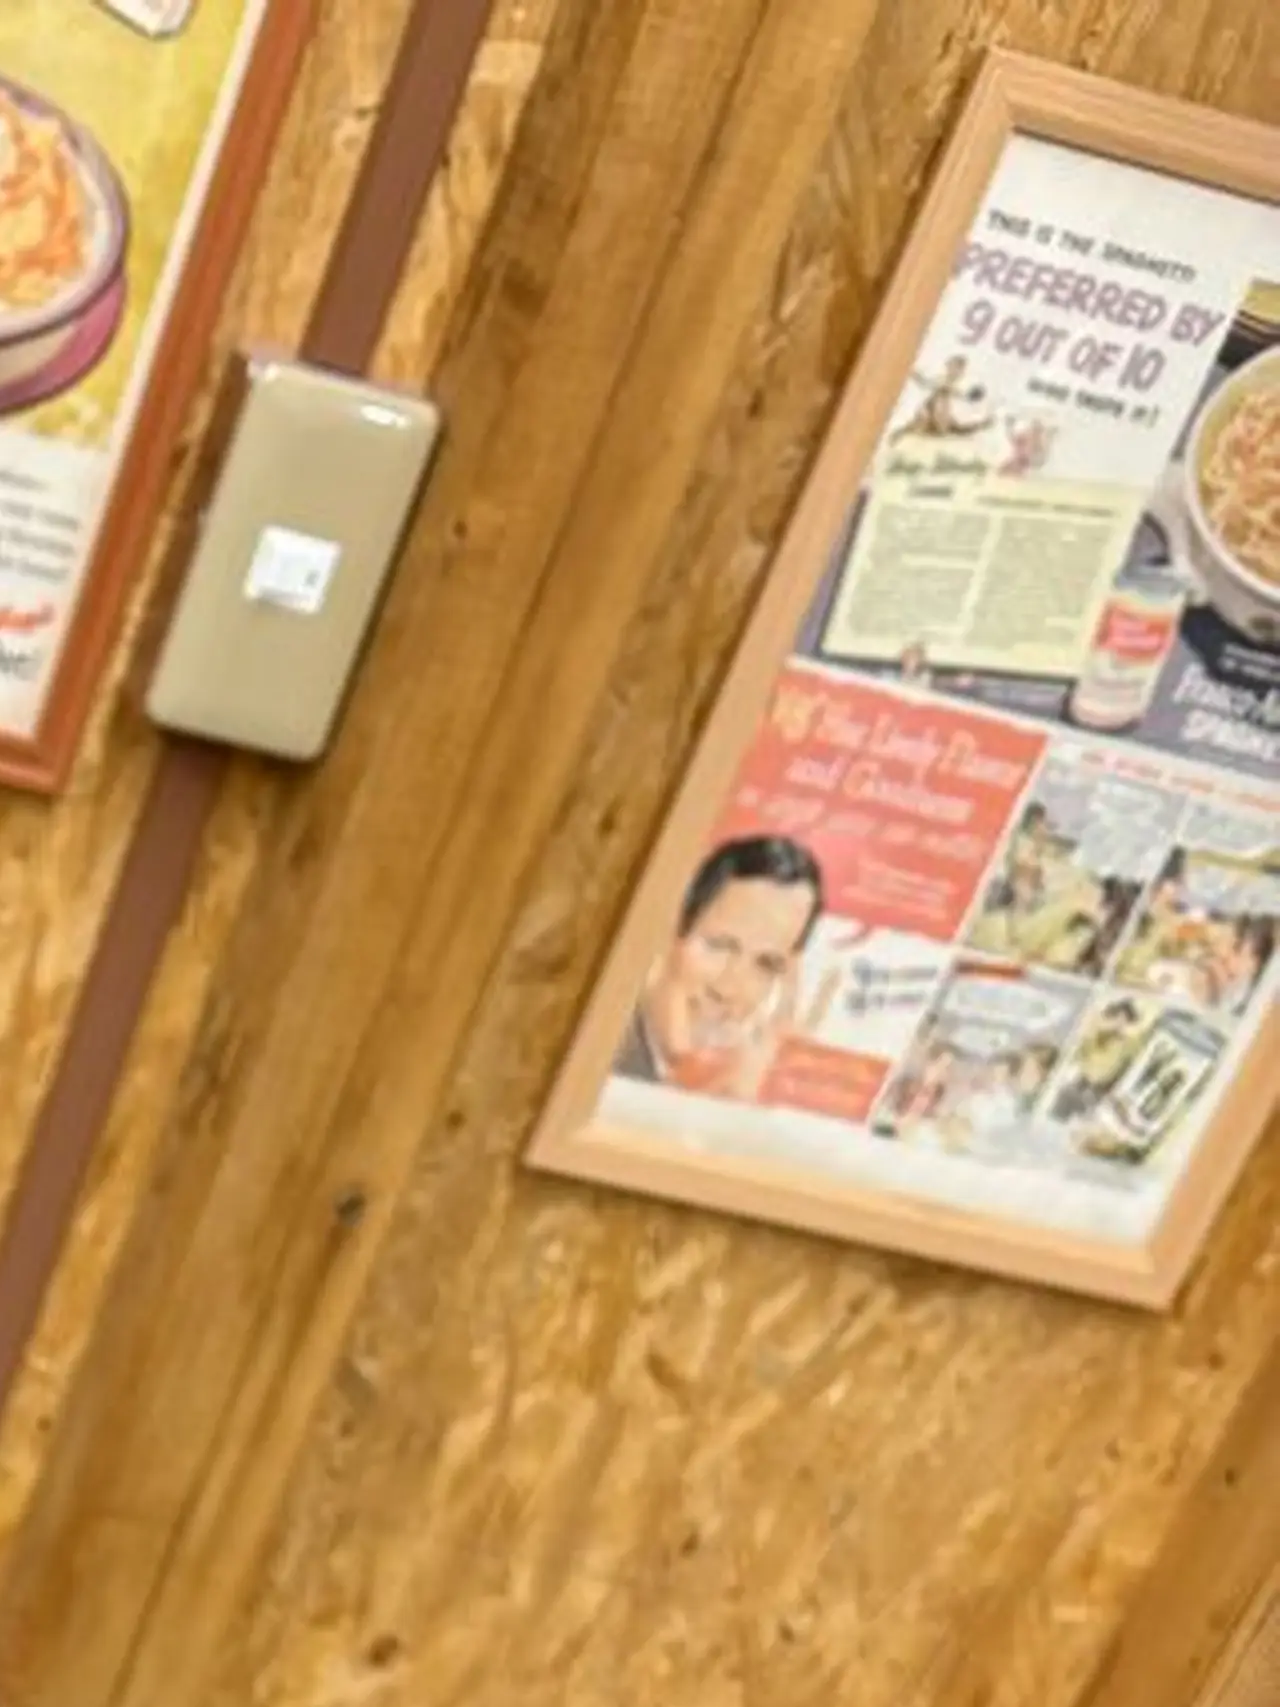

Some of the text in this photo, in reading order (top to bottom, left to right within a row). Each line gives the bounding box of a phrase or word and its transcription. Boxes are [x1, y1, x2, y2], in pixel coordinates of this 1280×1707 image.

[1058, 229, 1095, 256] THE
[956, 243, 1227, 347] PREFERRED BY
[959, 299, 1167, 392] 9 OUT OF 10
